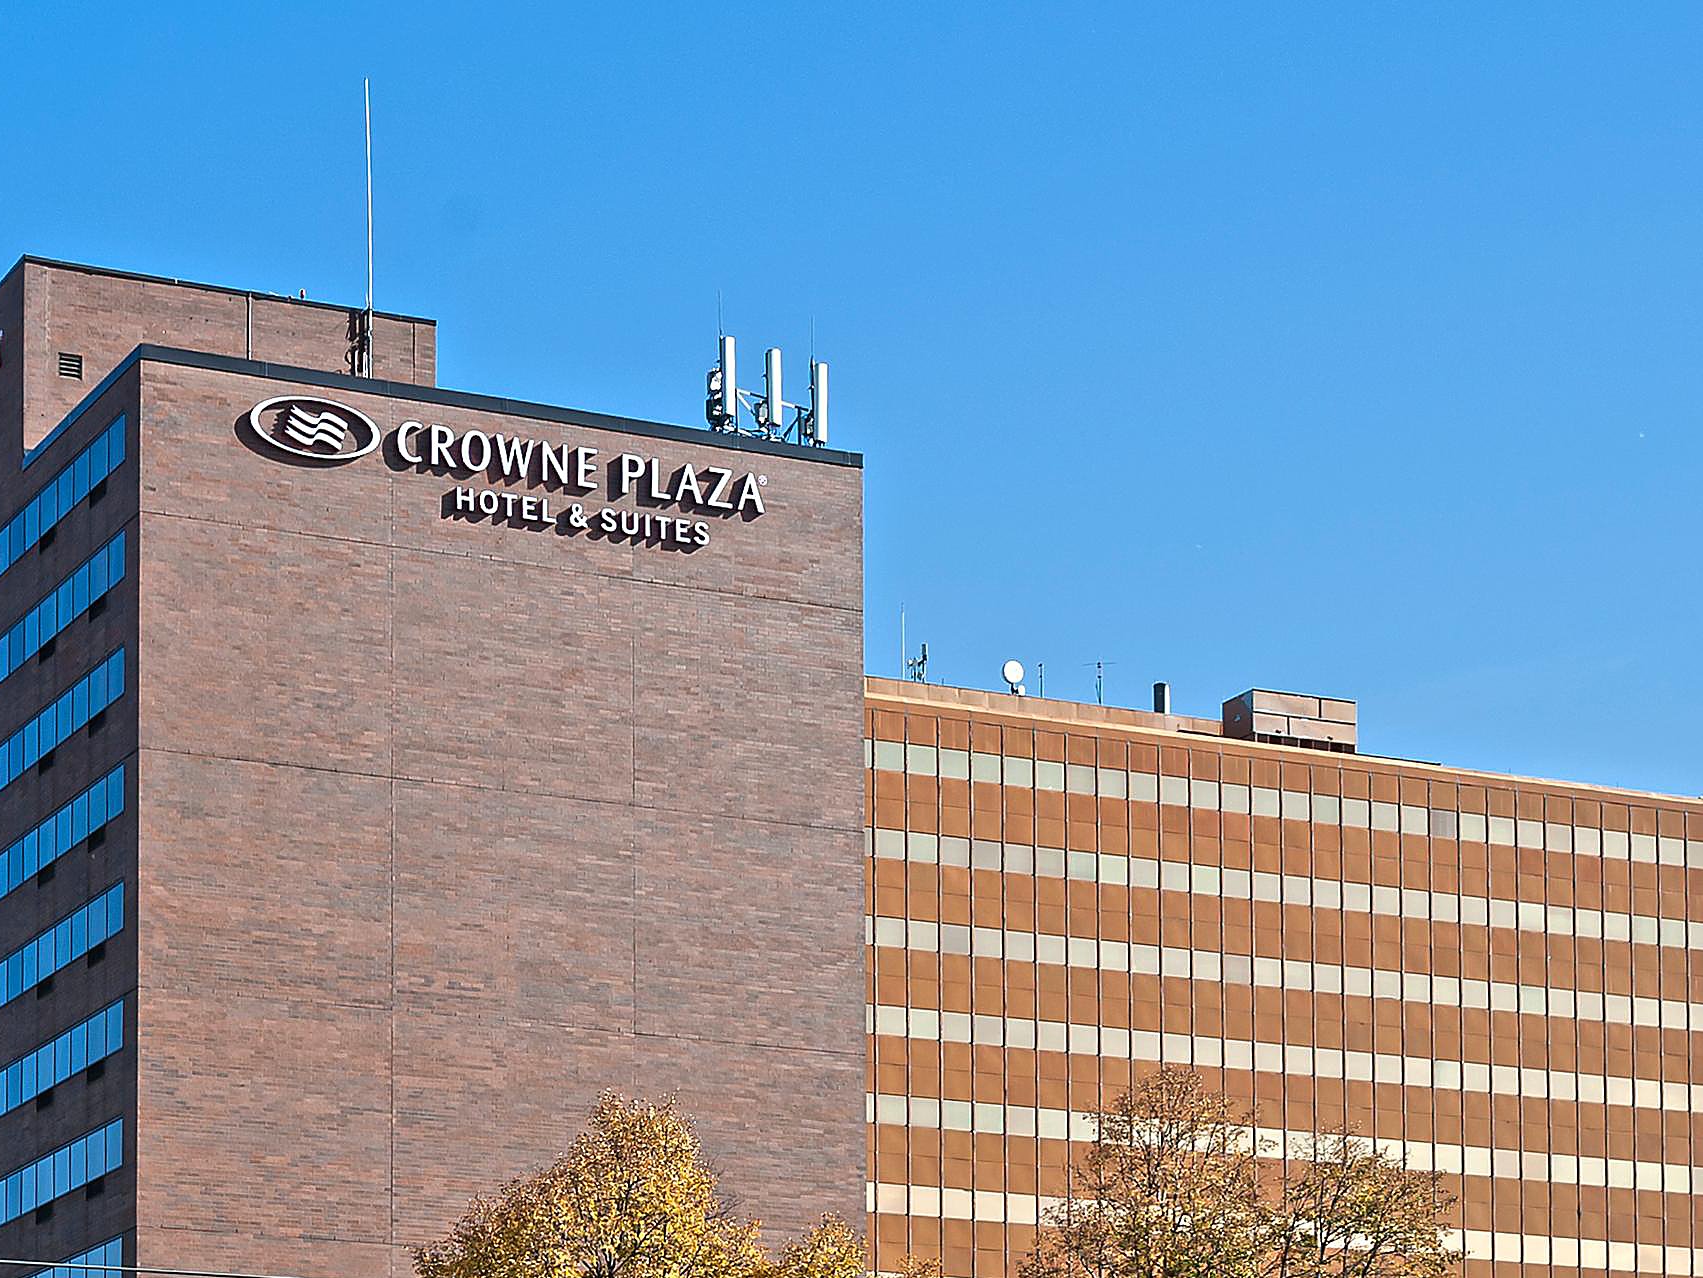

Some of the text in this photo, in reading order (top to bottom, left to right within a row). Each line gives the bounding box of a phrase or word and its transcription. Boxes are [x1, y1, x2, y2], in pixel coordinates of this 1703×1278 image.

[397, 420, 766, 514] CROWNE PLAZA
[456, 486, 710, 546] HOTEL & SUITES
